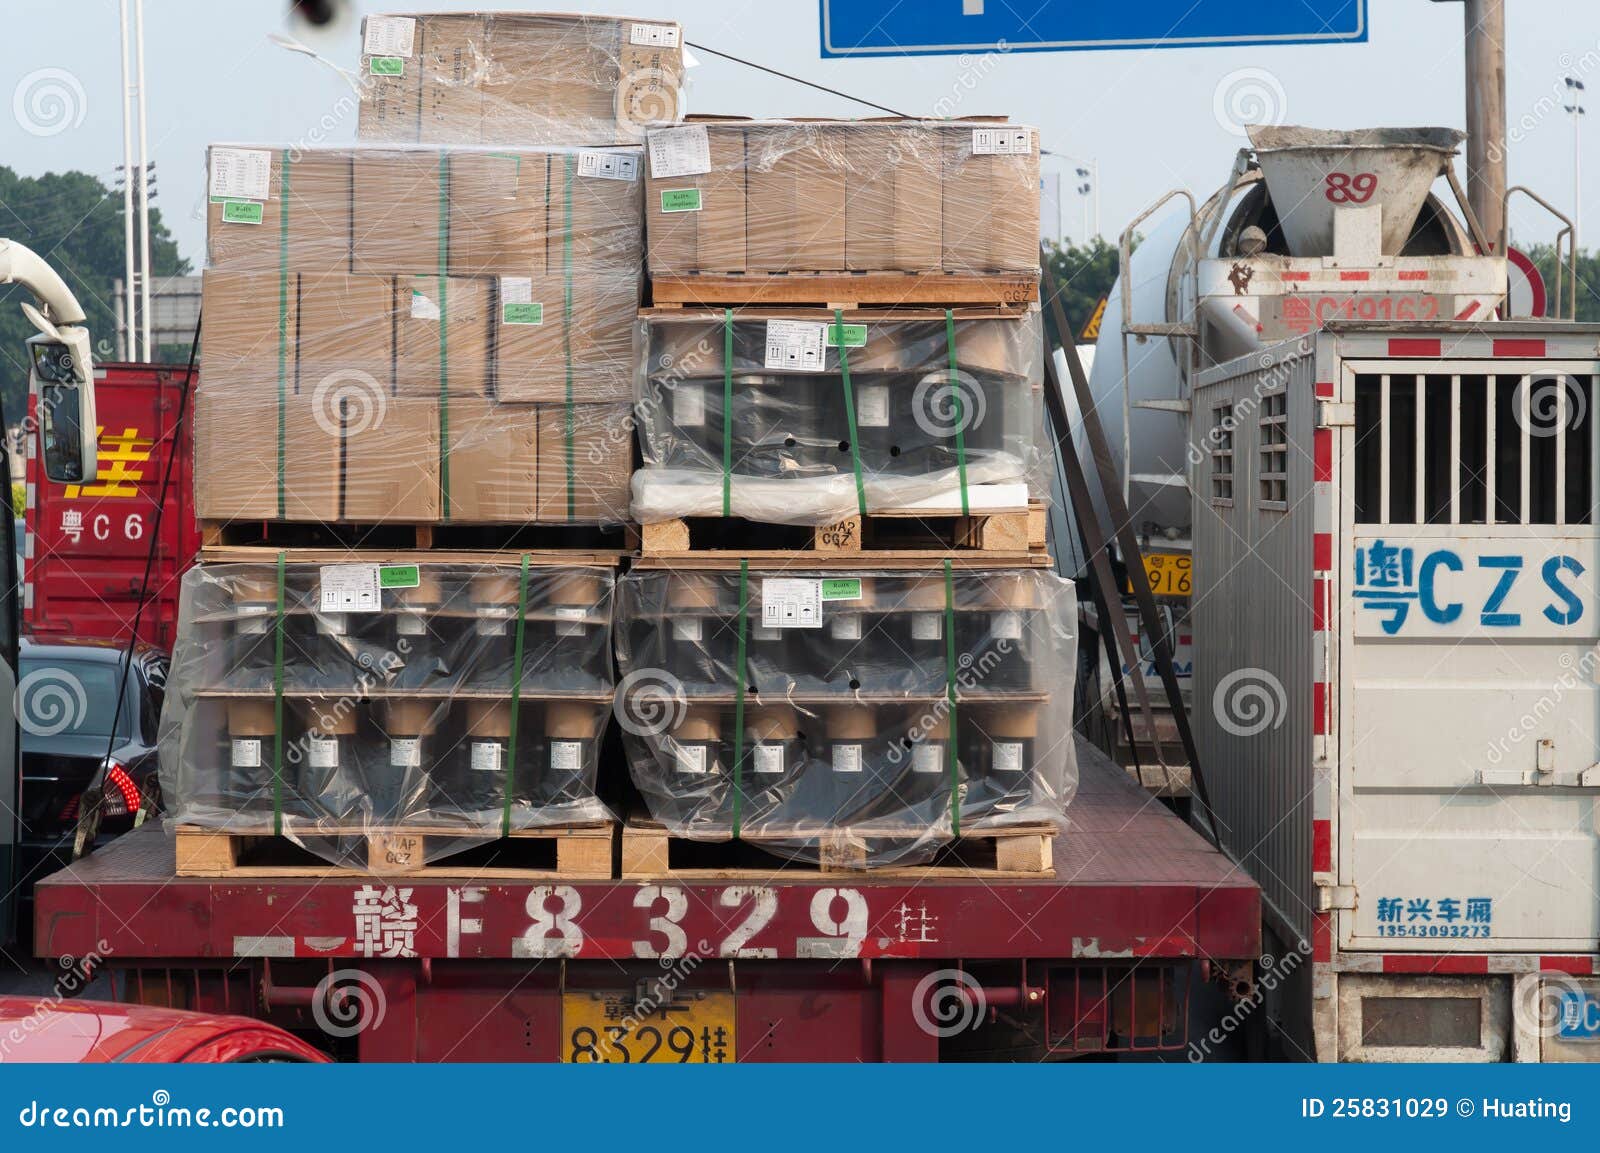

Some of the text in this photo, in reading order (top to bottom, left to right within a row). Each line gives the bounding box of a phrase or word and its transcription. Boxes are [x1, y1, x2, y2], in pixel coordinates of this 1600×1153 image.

[1325, 172, 1378, 203] 89
[1377, 897, 1492, 922] 新兴车厢
[1377, 925, 1491, 938] 13543093273
